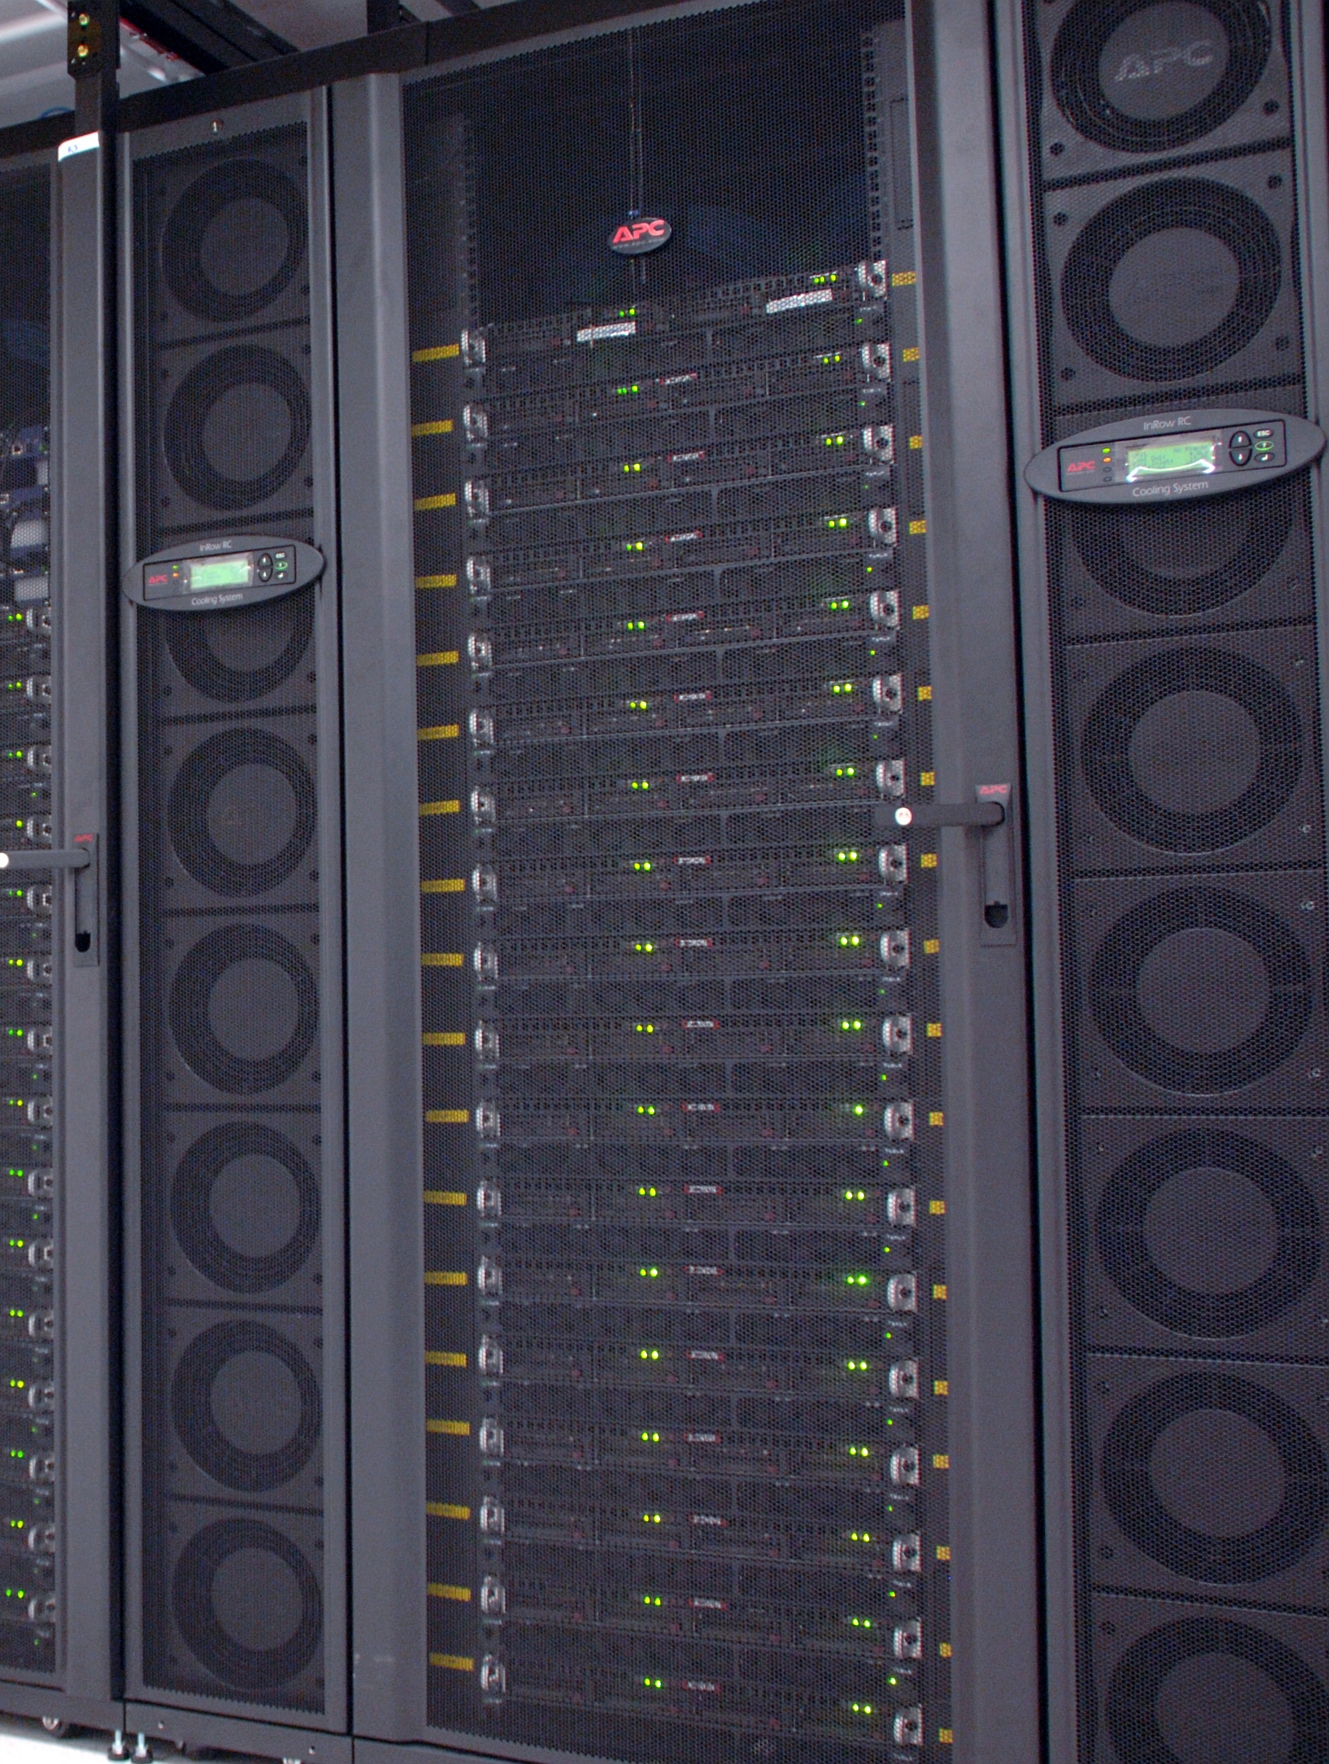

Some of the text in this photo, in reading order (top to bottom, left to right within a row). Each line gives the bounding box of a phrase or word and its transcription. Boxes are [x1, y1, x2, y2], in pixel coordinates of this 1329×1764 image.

[1115, 39, 1213, 81] APC
[612, 219, 665, 244] APC
[1143, 415, 1192, 431] InRow RC
[1067, 460, 1096, 473] APC
[1132, 480, 1209, 498] Cooling System
[147, 574, 169, 584] APC
[191, 592, 243, 606] Cooling System
[979, 784, 1008, 795] APC
